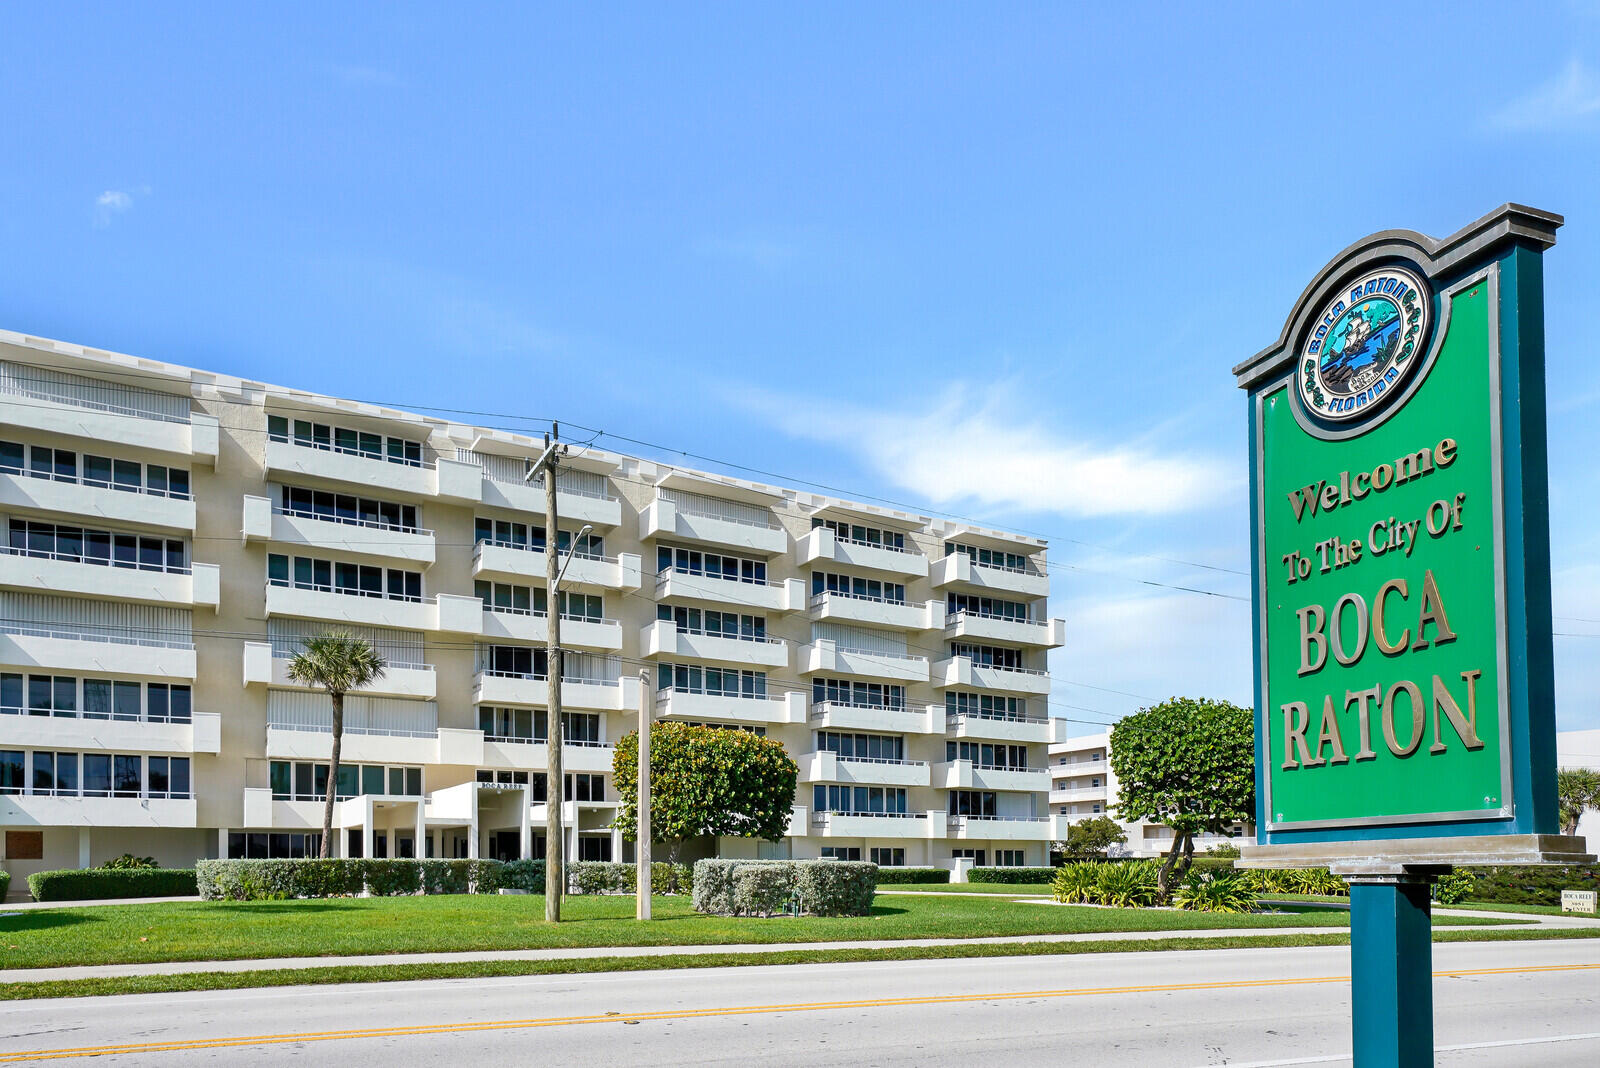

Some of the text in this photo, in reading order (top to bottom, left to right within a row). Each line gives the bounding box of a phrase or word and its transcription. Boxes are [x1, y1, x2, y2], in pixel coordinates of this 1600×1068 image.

[1308, 277, 1409, 355] BOCA RATON
[1328, 366, 1399, 412] FLORIDA
[1287, 438, 1458, 524] Welcome
[1282, 492, 1466, 585] To The City Of
[1295, 569, 1457, 678] BOCA
[1280, 669, 1484, 771] RATON
